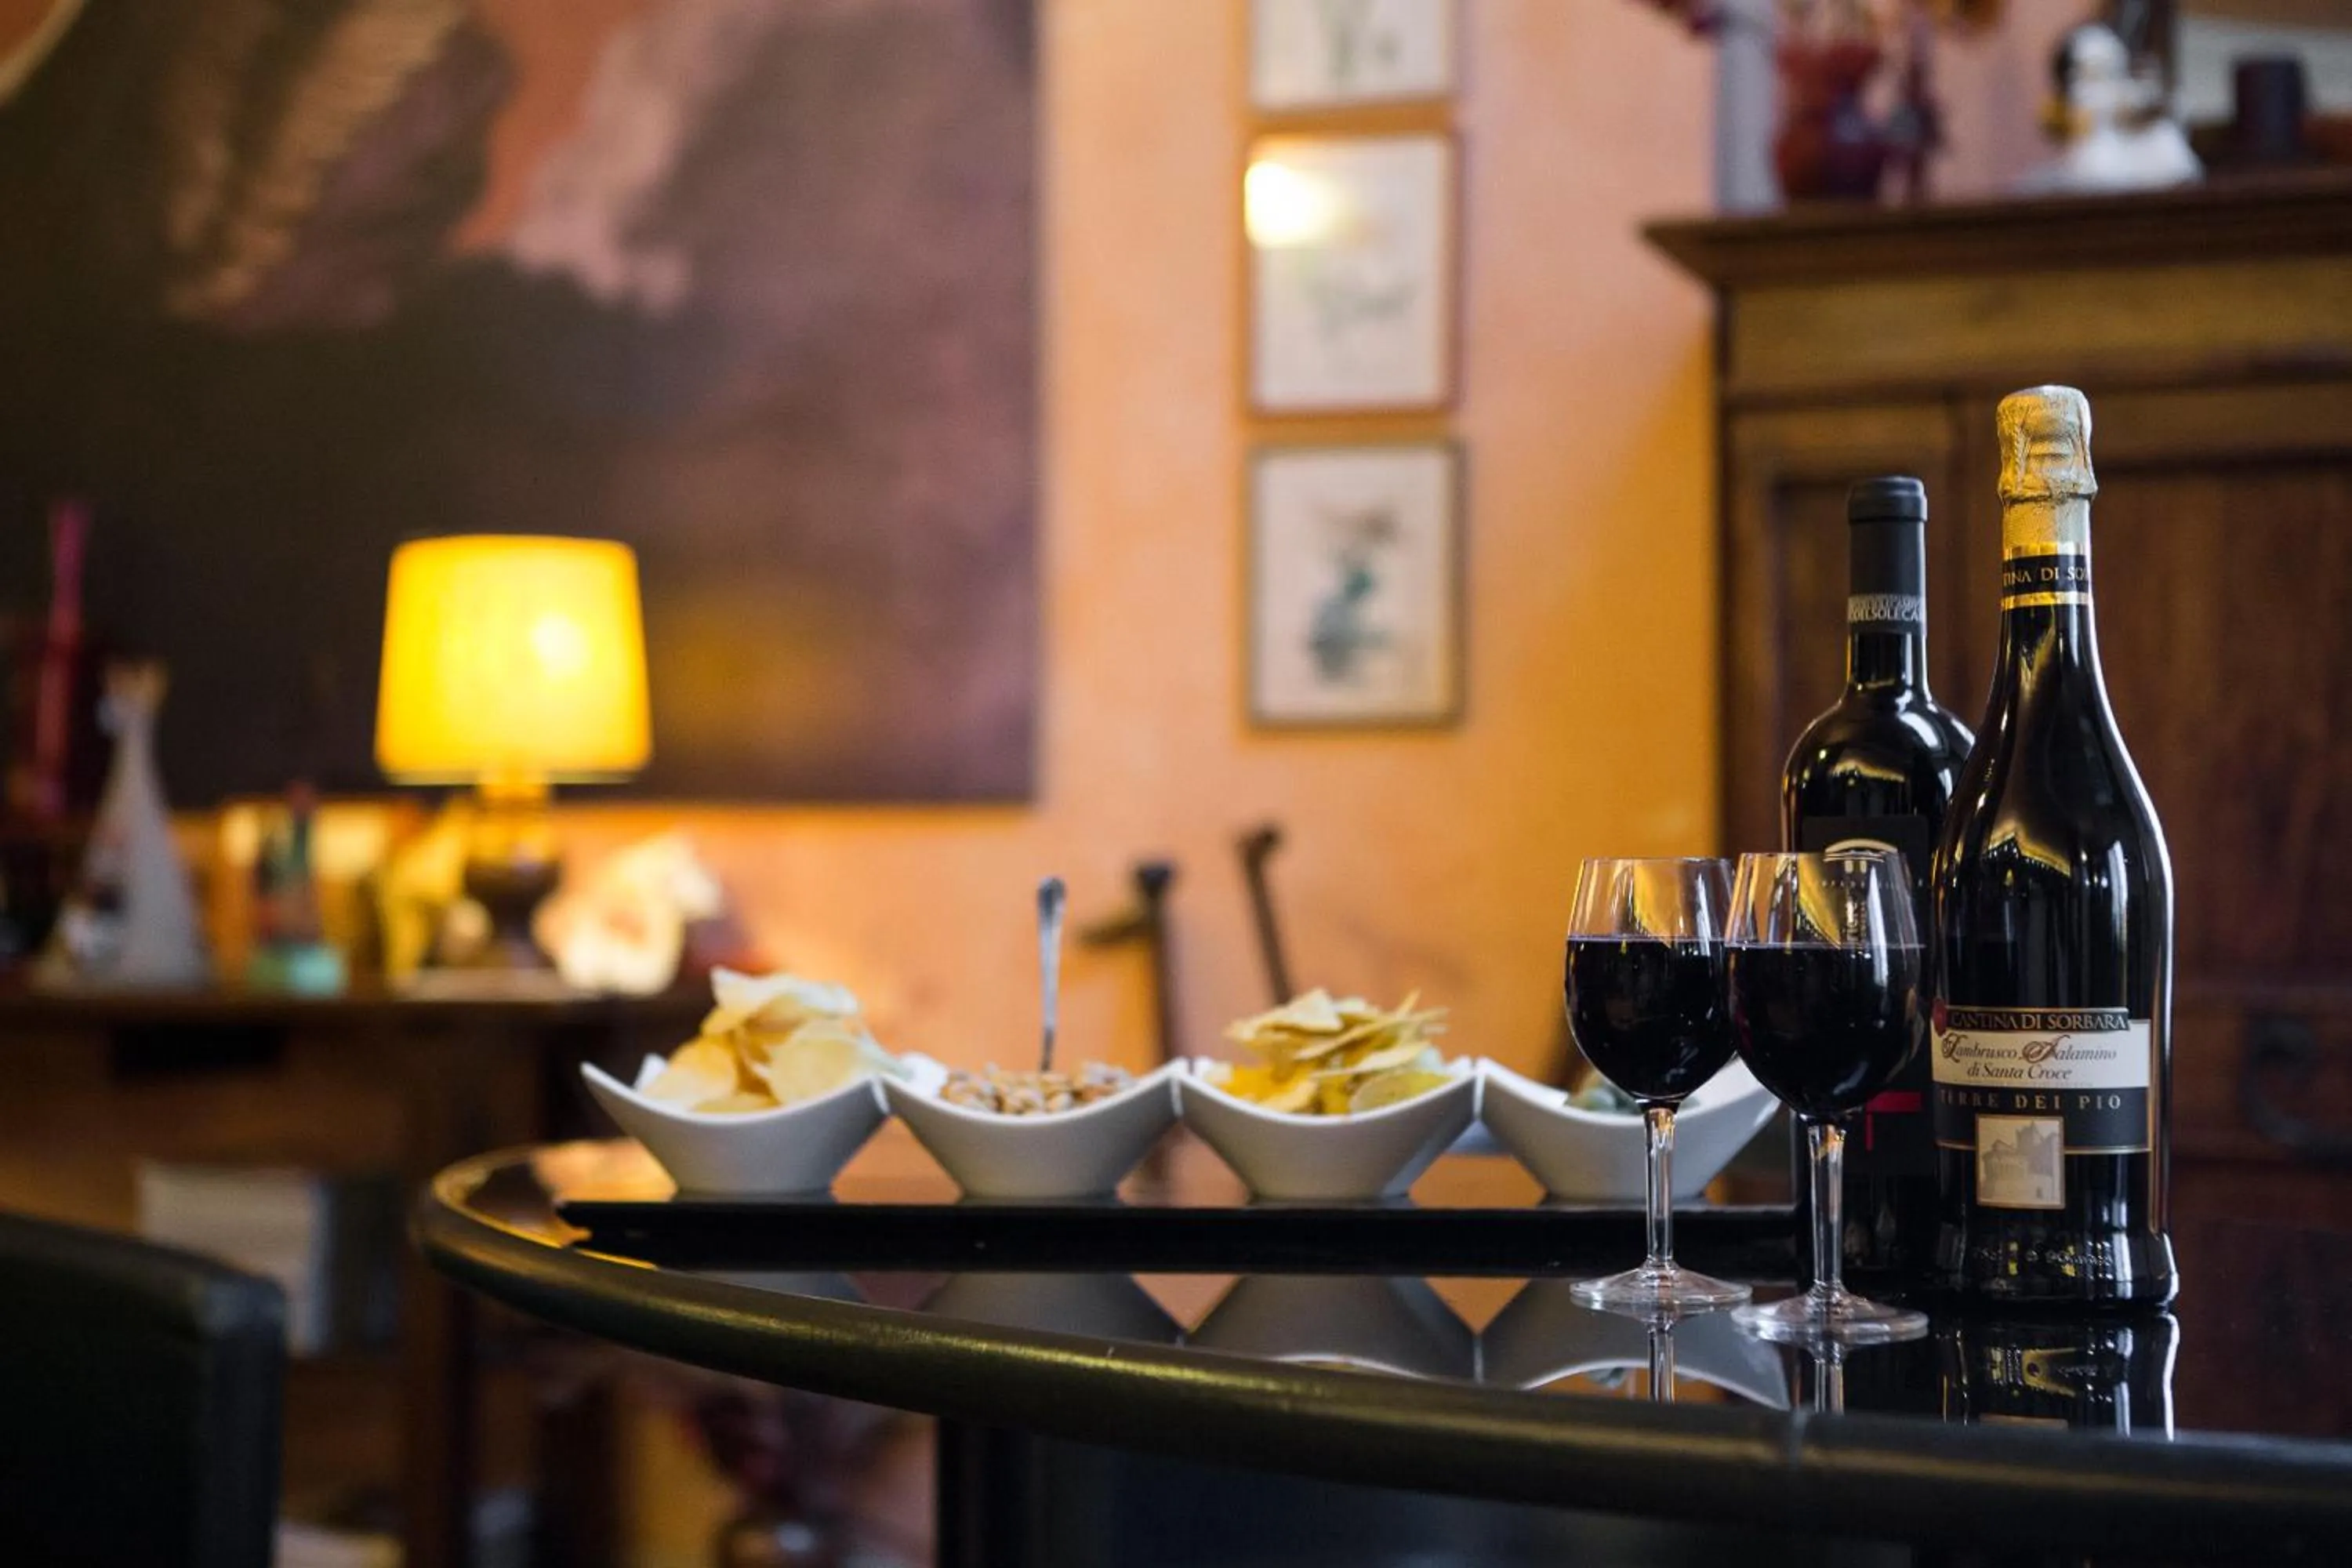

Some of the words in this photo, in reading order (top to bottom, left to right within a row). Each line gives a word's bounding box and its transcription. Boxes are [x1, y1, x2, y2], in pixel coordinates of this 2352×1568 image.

[2041, 567, 2060, 581] DI
[1951, 1011, 2018, 1029] CANTINA
[2021, 1014, 2042, 1029] DI
[2047, 1014, 2127, 1029] SORBARA
[1941, 1033, 2017, 1063] Lambrusco
[2018, 1034, 2117, 1064] Salamino
[1967, 1062, 1980, 1077] di
[1982, 1063, 2024, 1080] Santa
[2027, 1064, 2072, 1080] Croce
[2016, 1094, 2060, 1109] DEI
[2079, 1094, 2122, 1110] PIO
